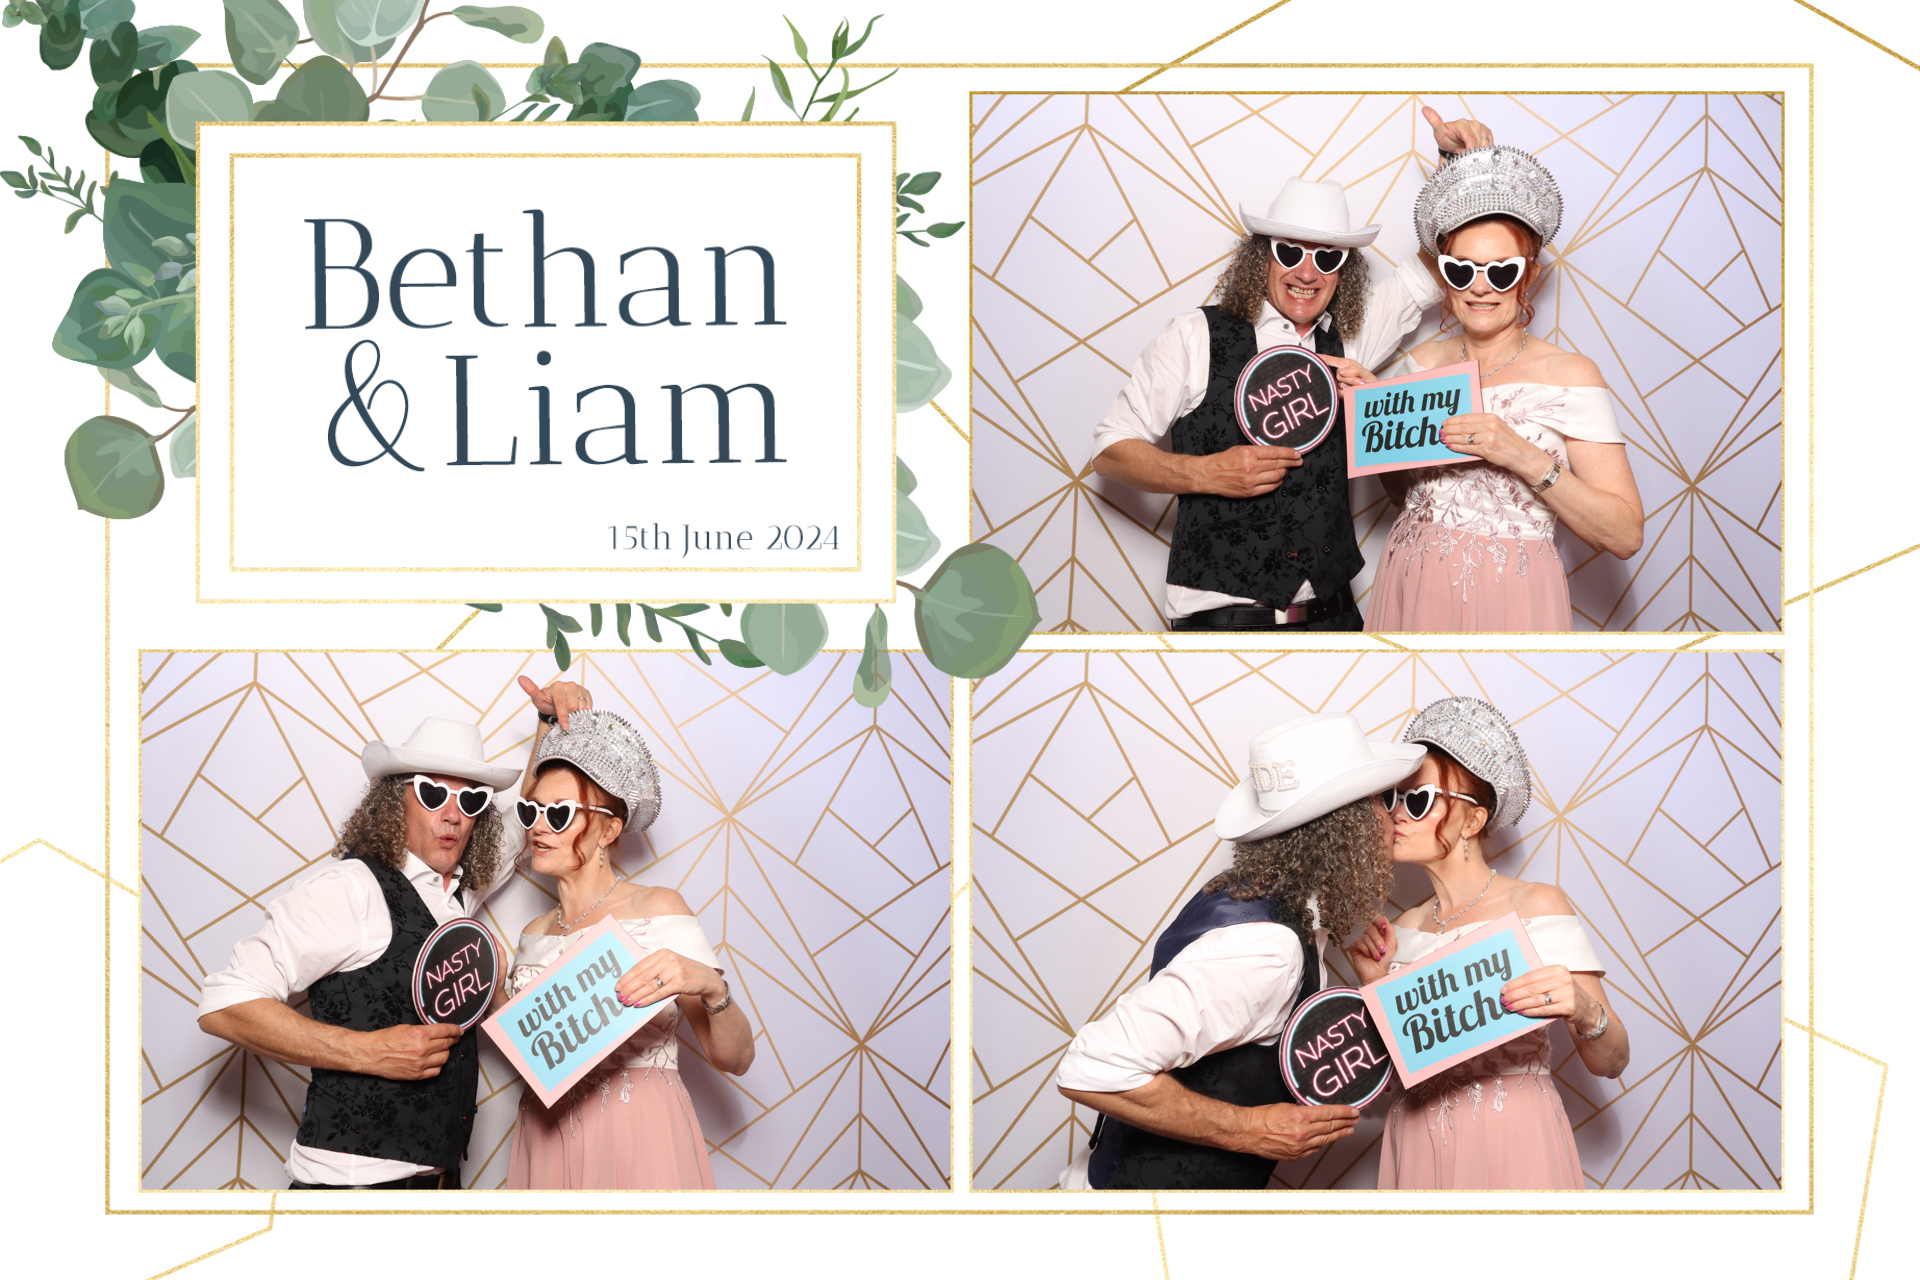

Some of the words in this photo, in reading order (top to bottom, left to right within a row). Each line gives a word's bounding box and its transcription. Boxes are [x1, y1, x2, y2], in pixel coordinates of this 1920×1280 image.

[1247, 363, 1313, 412] NASTY
[1363, 389, 1415, 418] with
[1421, 388, 1461, 416] my
[1261, 392, 1330, 439] GIRL
[1361, 415, 1444, 453] Bitch
[1249, 760, 1300, 792] DE
[425, 937, 481, 989] NASTY
[1395, 966, 1460, 1015] with
[1464, 948, 1512, 987] my
[434, 968, 491, 1017] GIRL
[517, 982, 577, 1038] with
[576, 948, 622, 993] my
[531, 991, 631, 1070] Bitch
[1294, 1006, 1368, 1068] NASTY
[1312, 1039, 1388, 1097] GIRL
